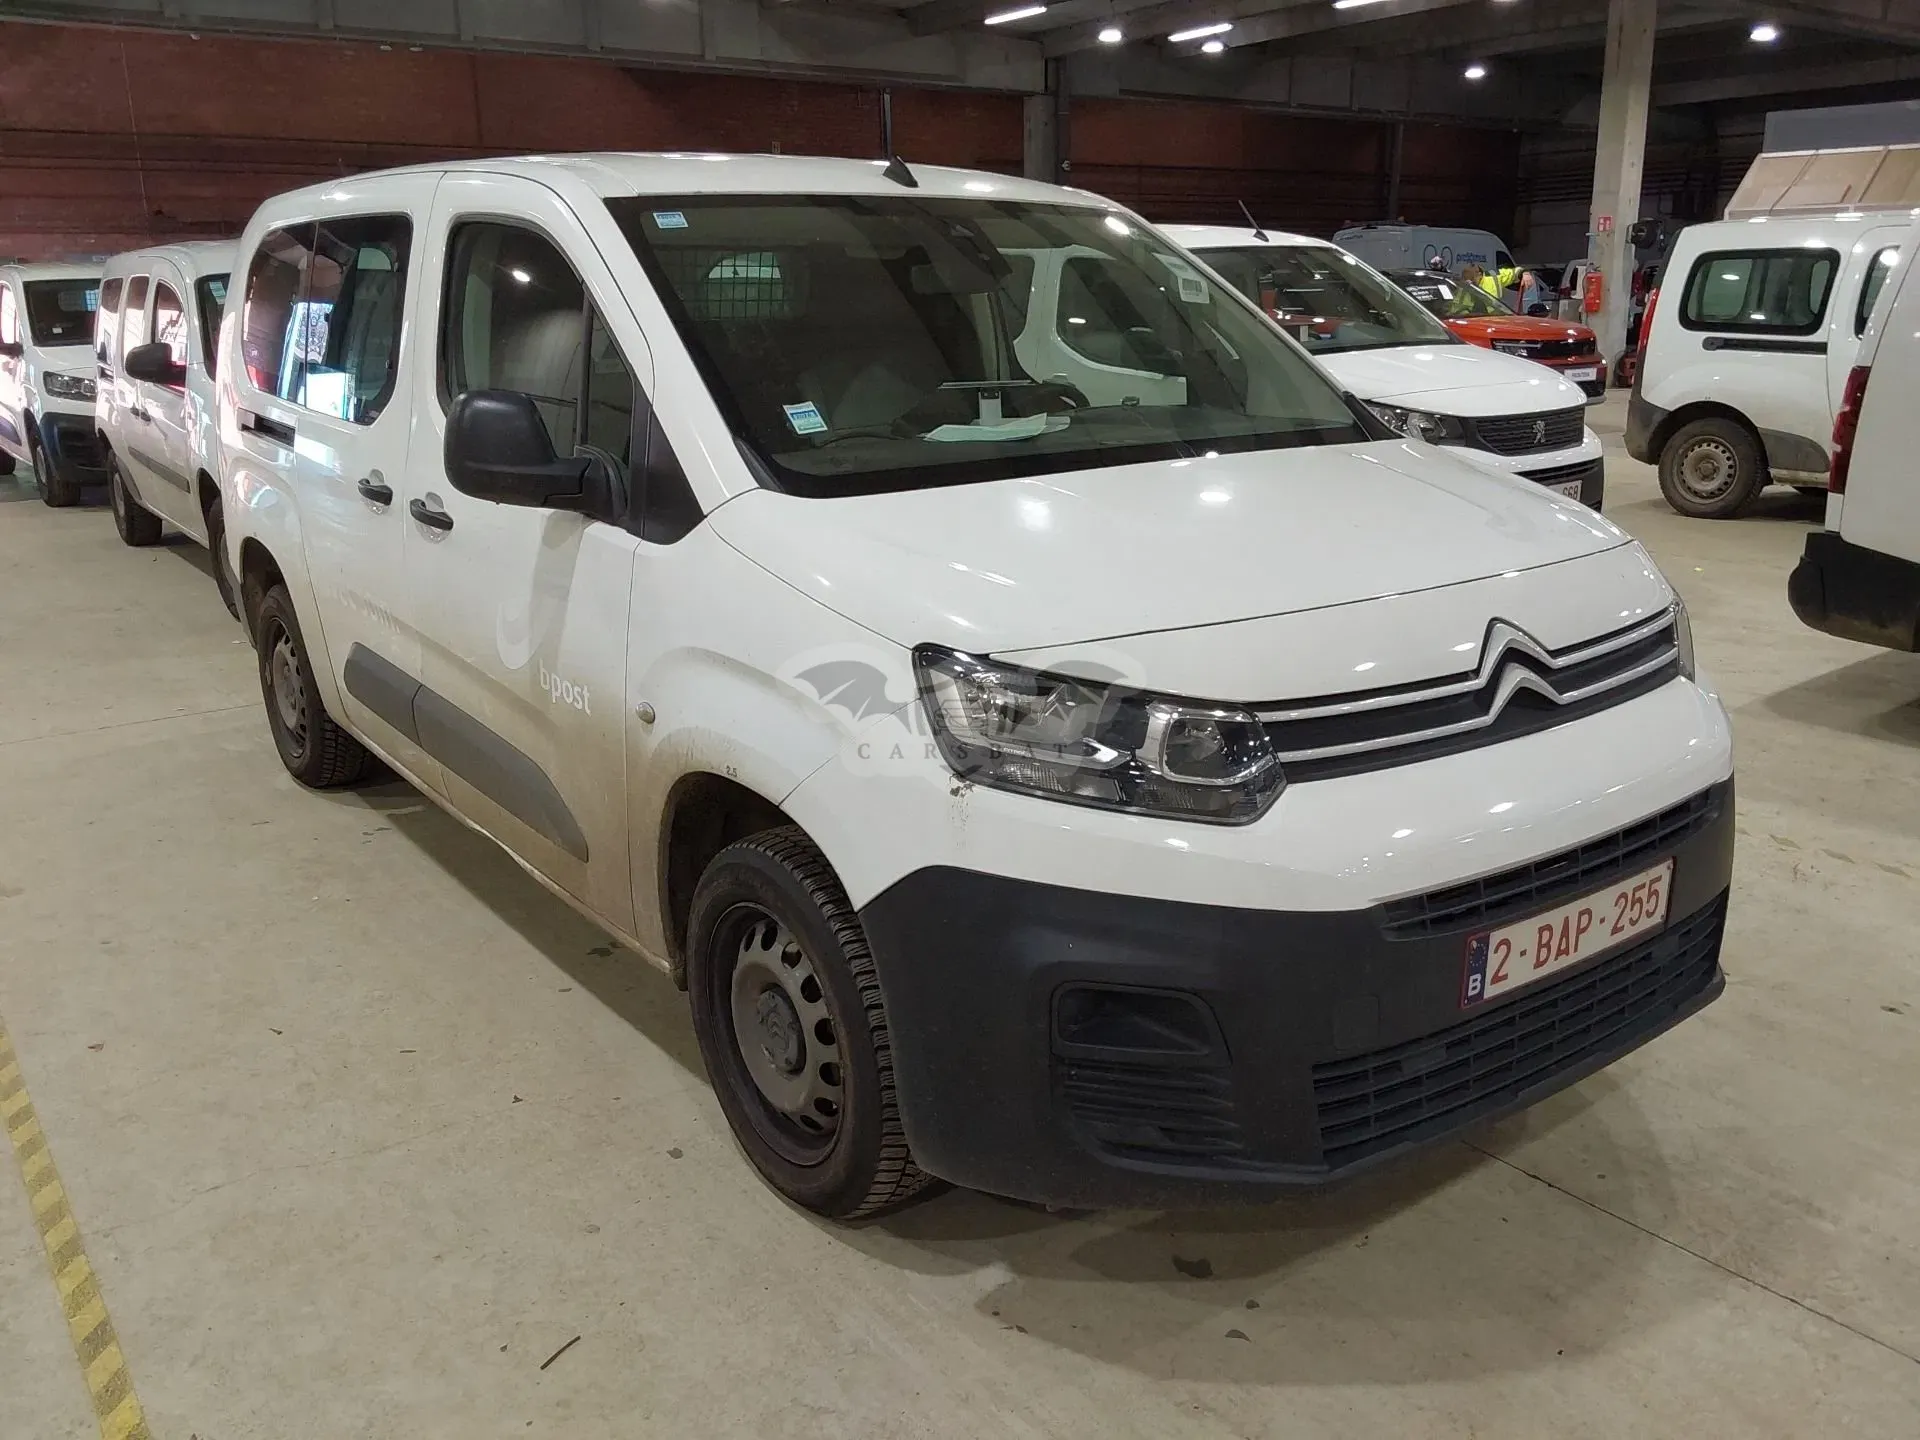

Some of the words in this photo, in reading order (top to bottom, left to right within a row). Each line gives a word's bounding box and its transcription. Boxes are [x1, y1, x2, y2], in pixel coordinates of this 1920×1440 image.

[538, 658, 592, 716] bpost
[1490, 875, 1663, 986] 2-BAP-255
[1468, 974, 1482, 997] B
